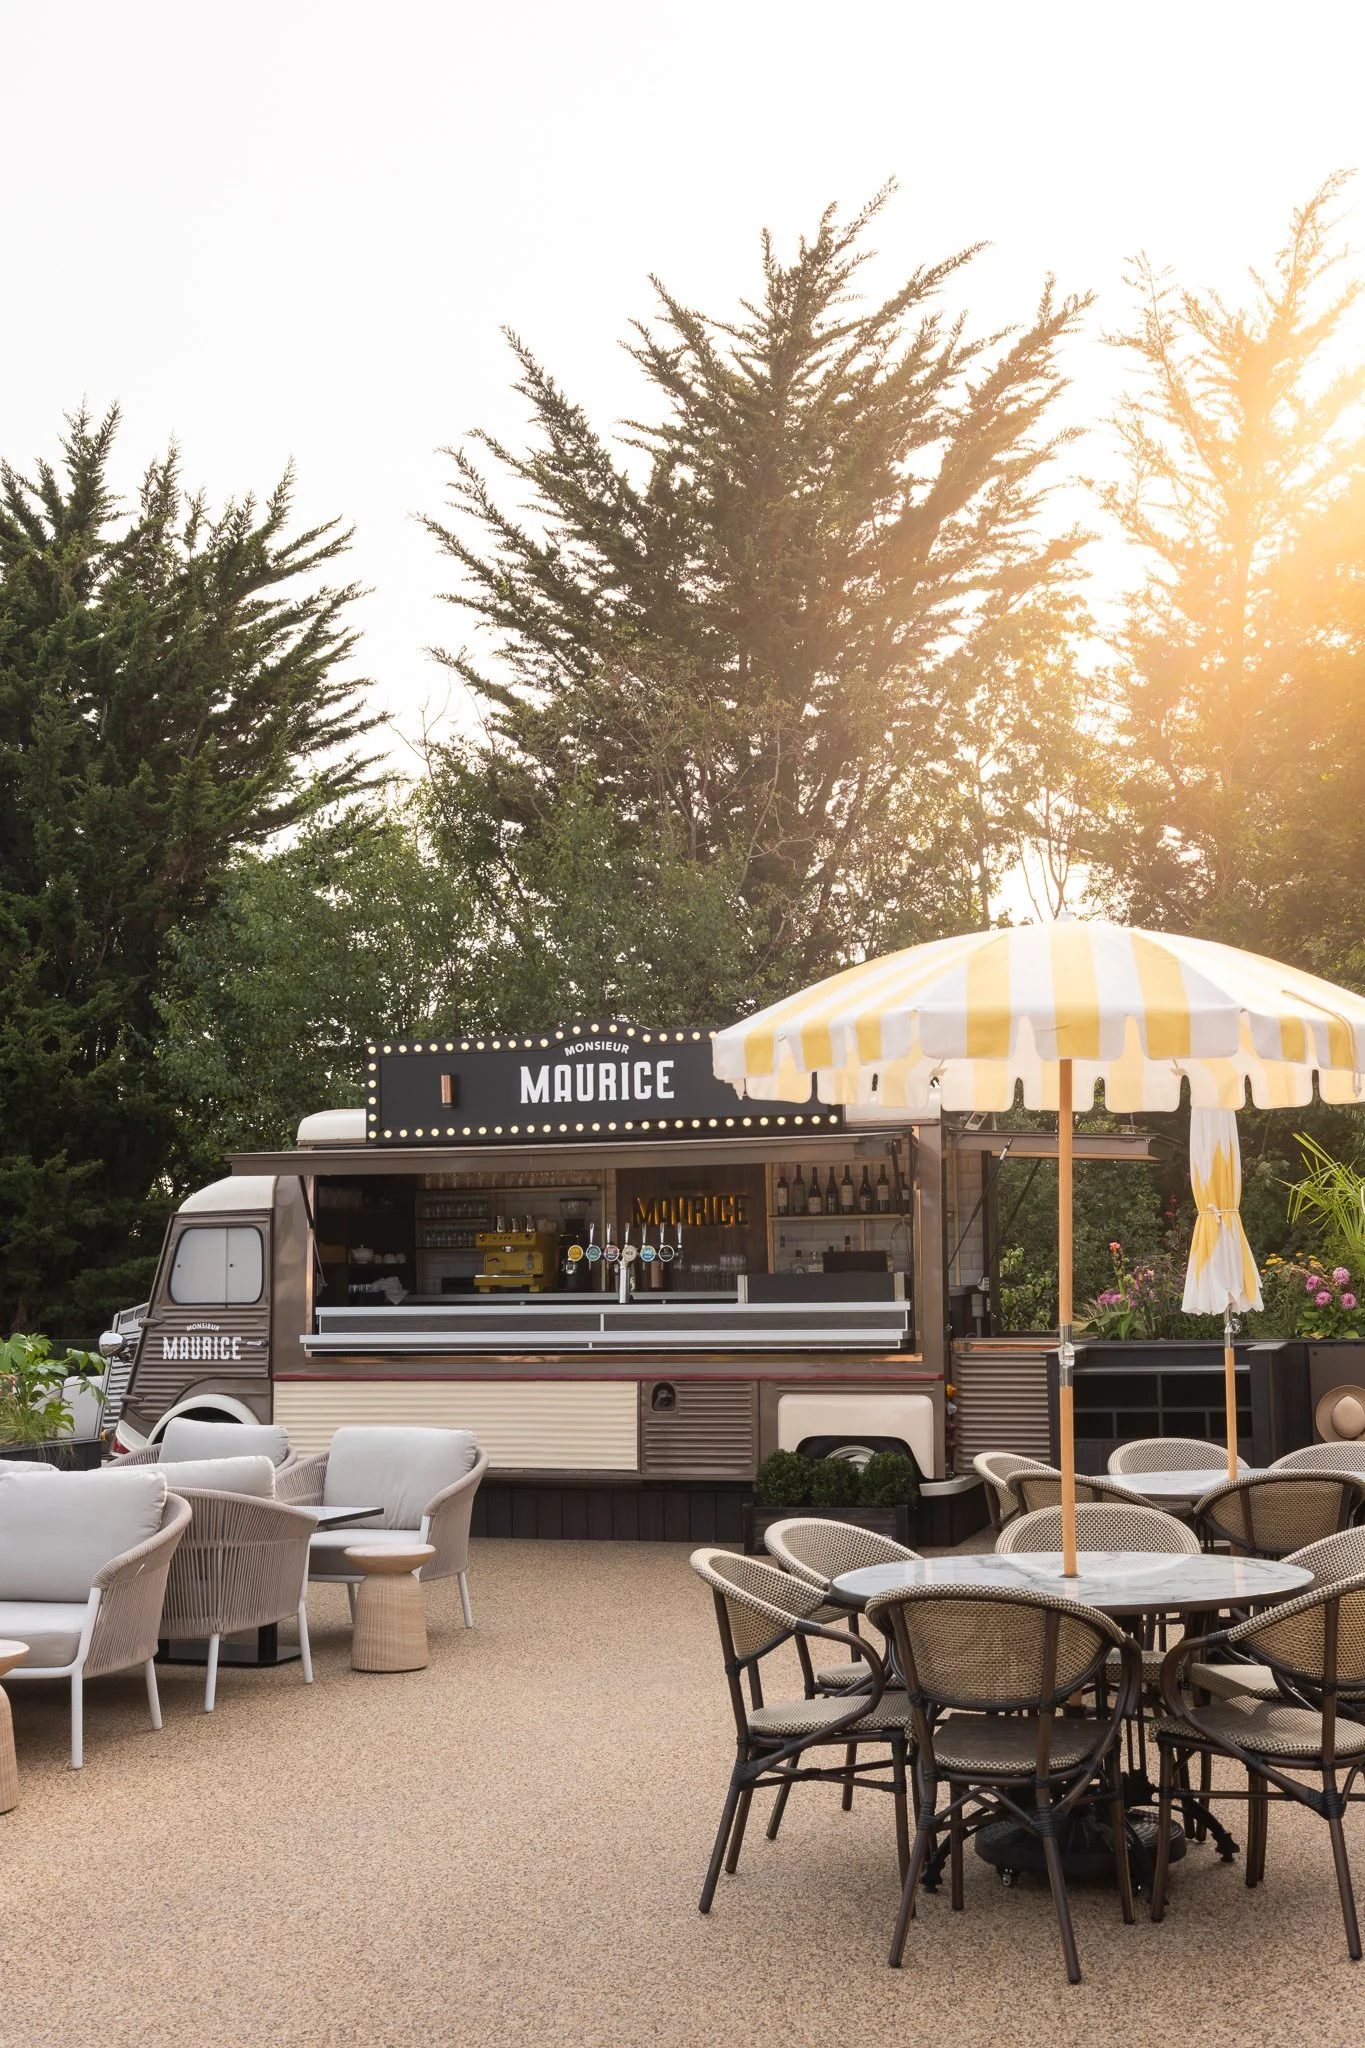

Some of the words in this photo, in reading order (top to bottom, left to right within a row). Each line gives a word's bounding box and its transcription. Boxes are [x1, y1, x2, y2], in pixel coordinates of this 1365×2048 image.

[564, 1041, 630, 1056] MONSIEUR
[520, 1060, 675, 1104] MAURICE
[632, 1195, 748, 1227] MAURICE
[186, 1322, 221, 1332] MONSIEUR
[162, 1336, 242, 1360] MAURICE
